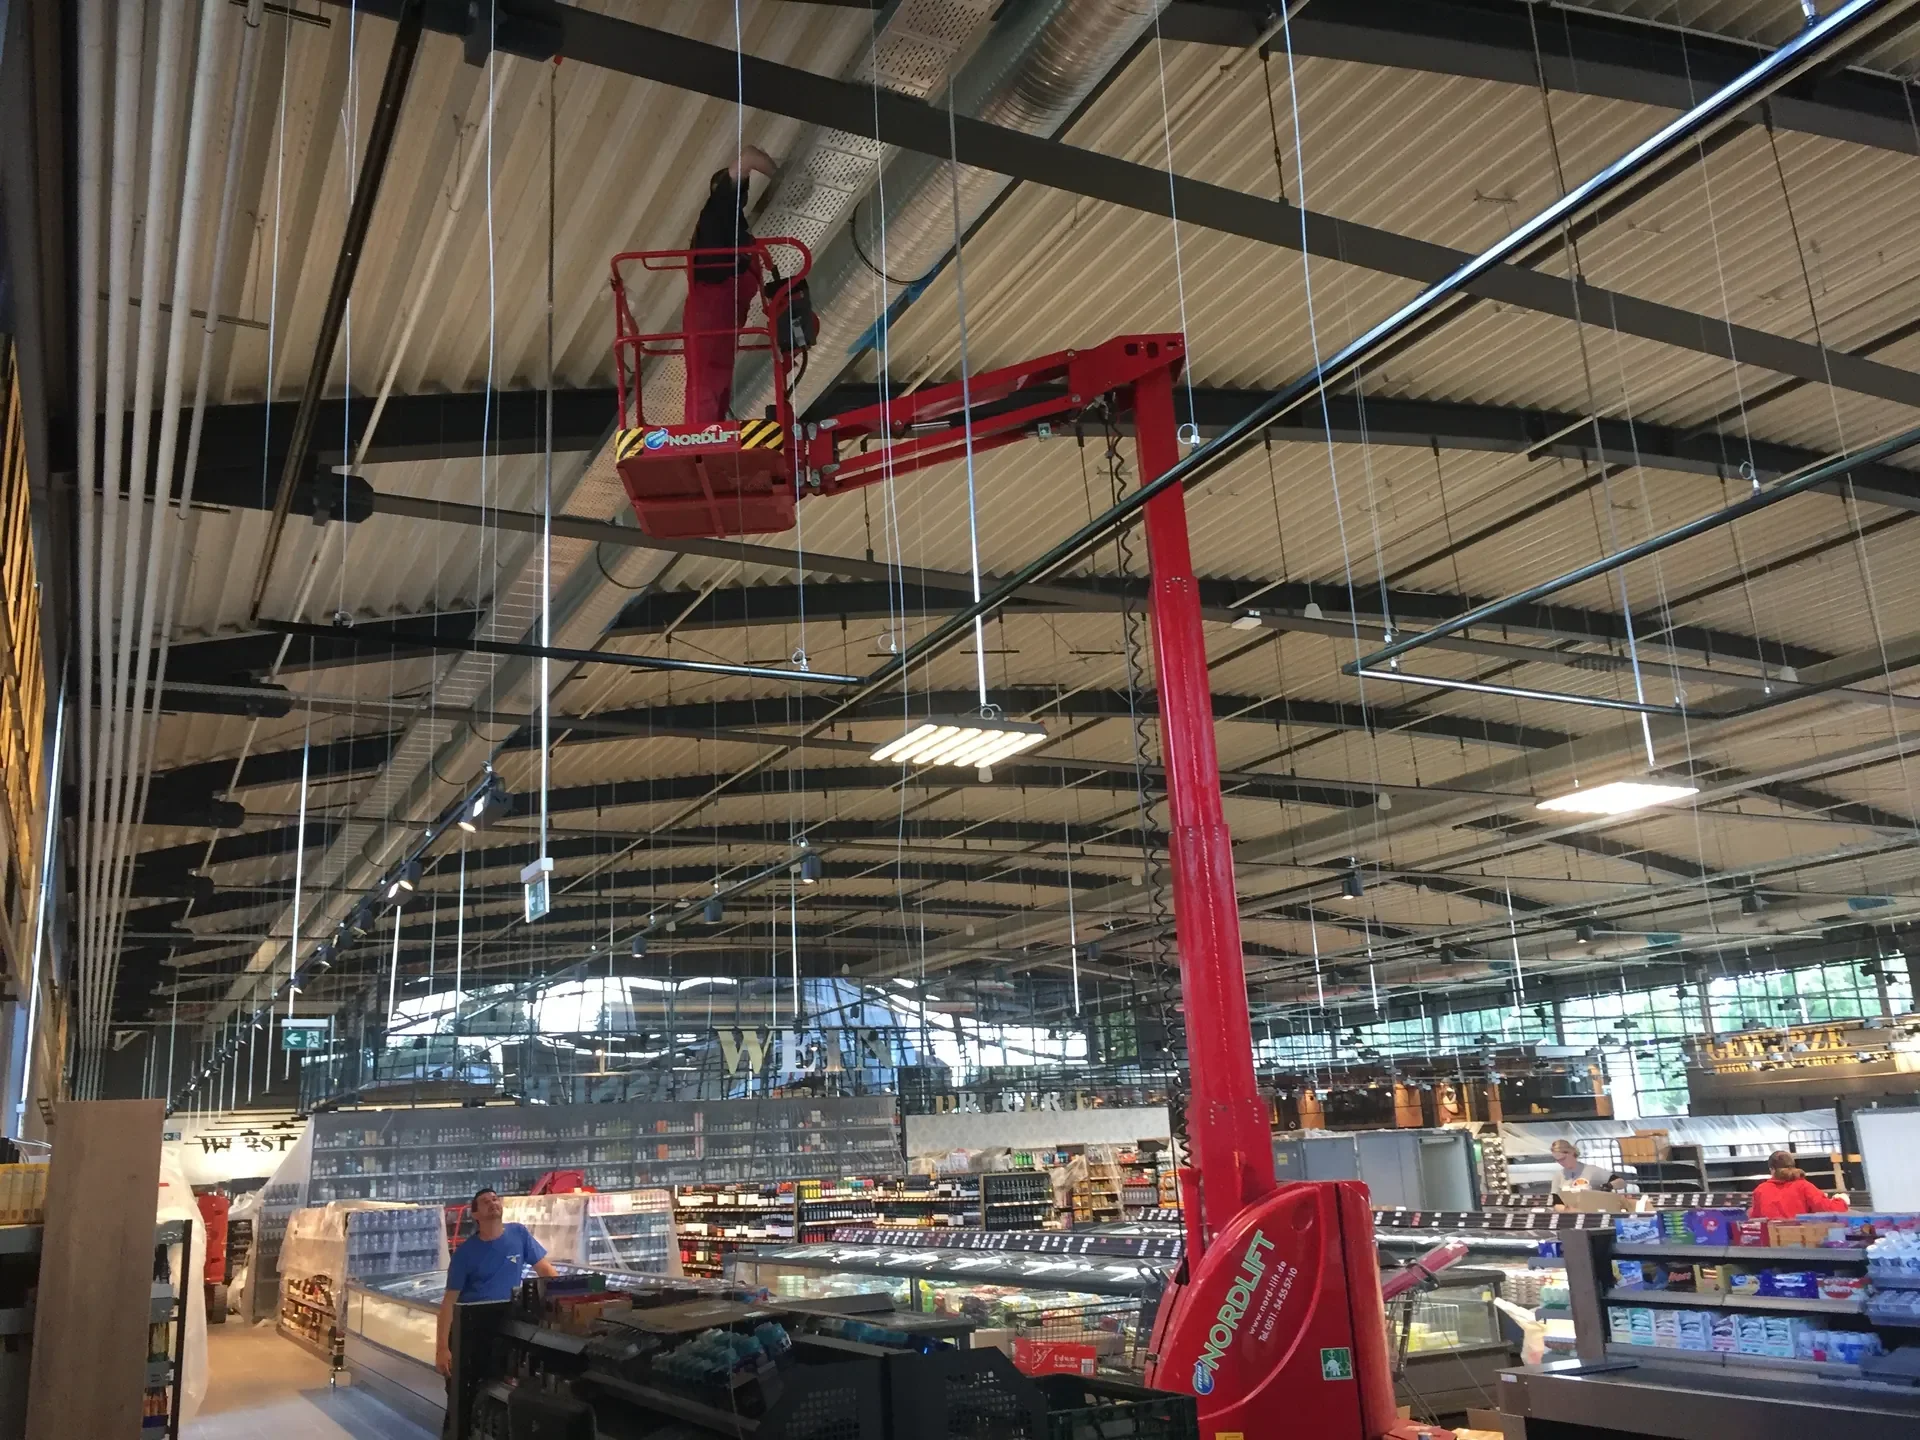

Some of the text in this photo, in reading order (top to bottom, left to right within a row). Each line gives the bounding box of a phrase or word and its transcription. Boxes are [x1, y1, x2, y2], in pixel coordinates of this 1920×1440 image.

[668, 430, 740, 446] NORDLIFT
[711, 1025, 895, 1074] WEIN
[1283, 1267, 1298, 1289] 57-10
[1198, 1229, 1275, 1371] NORDLIFT
[1249, 1260, 1287, 1335] www.nord-lift.de
[1273, 1298, 1284, 1311] 54
[1278, 1287, 1289, 1300] 55
